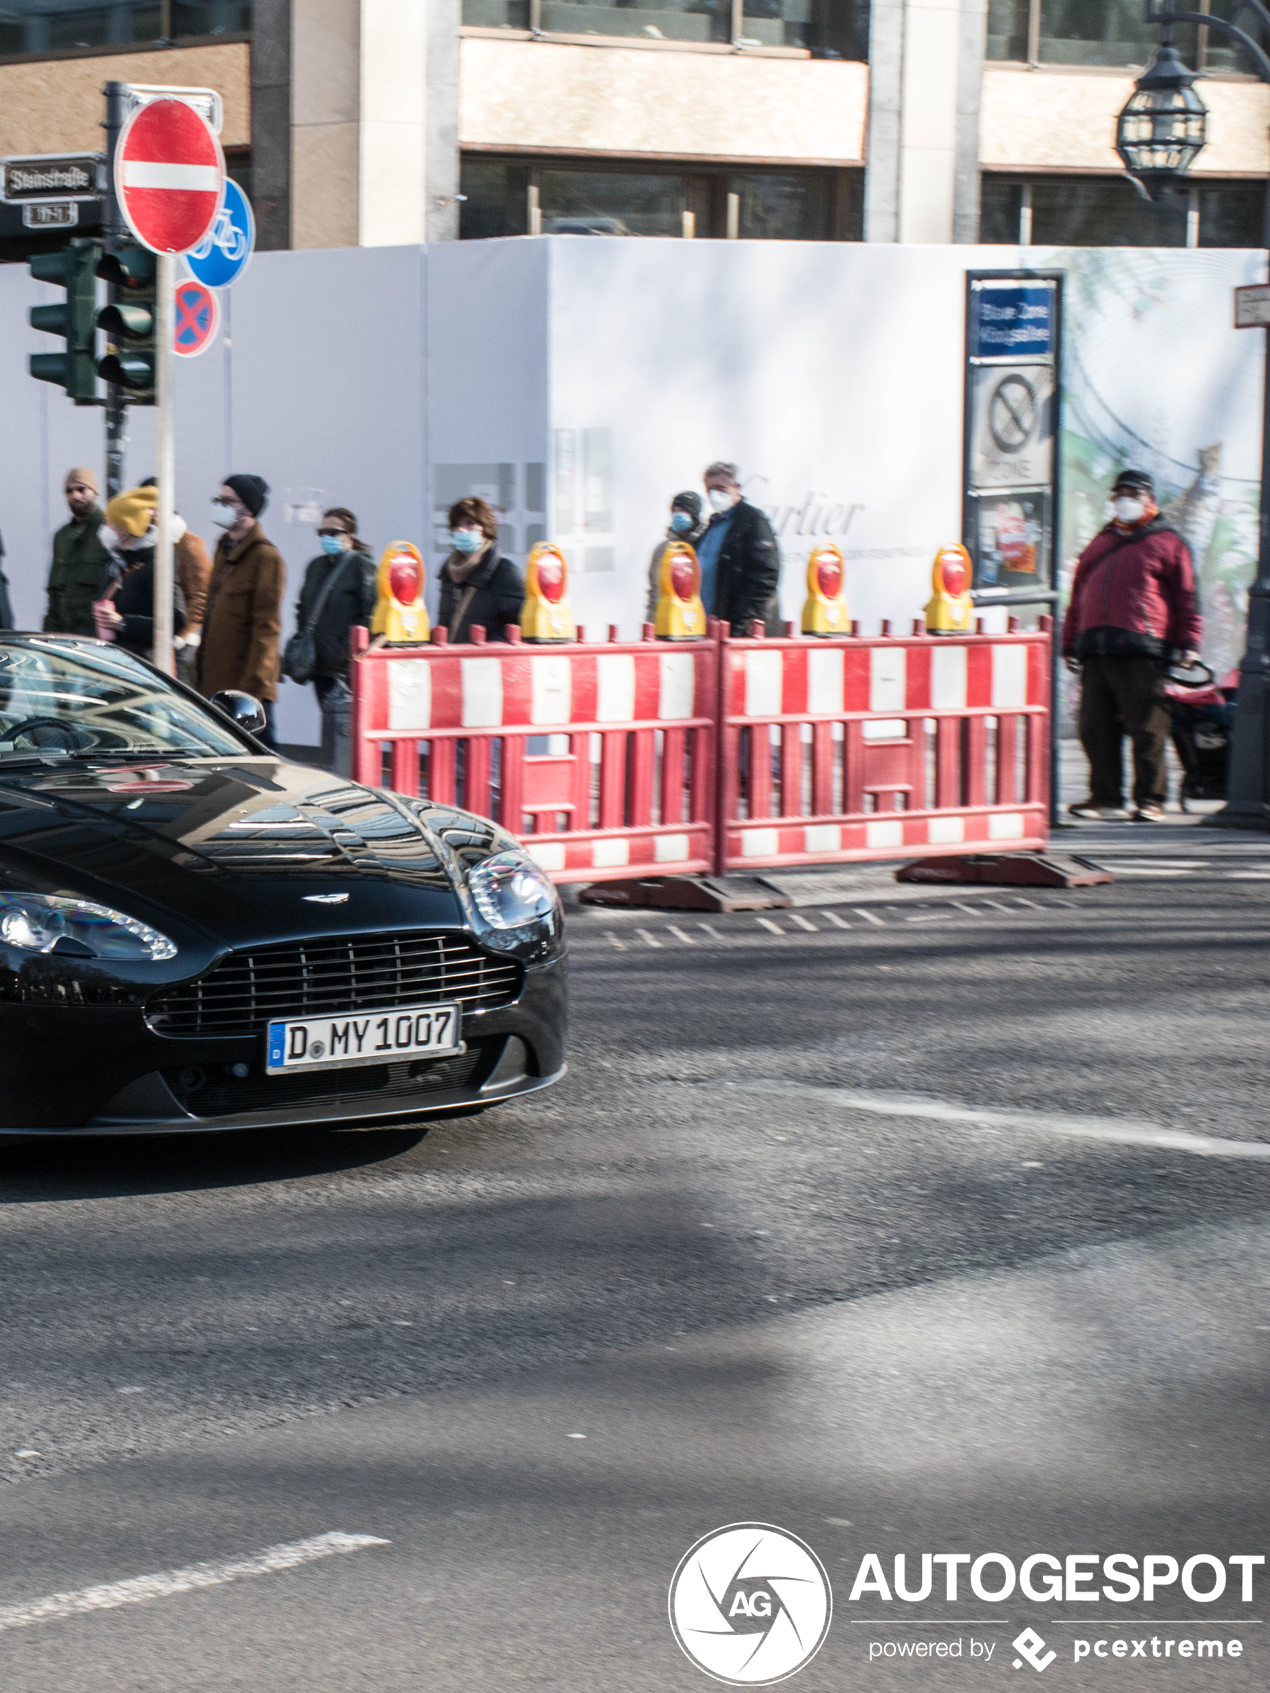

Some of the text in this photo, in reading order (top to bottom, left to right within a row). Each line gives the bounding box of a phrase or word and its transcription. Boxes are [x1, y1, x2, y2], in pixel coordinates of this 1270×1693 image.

[987, 460, 1032, 480] ZONE
[288, 1011, 451, 1060] D MY 1007
